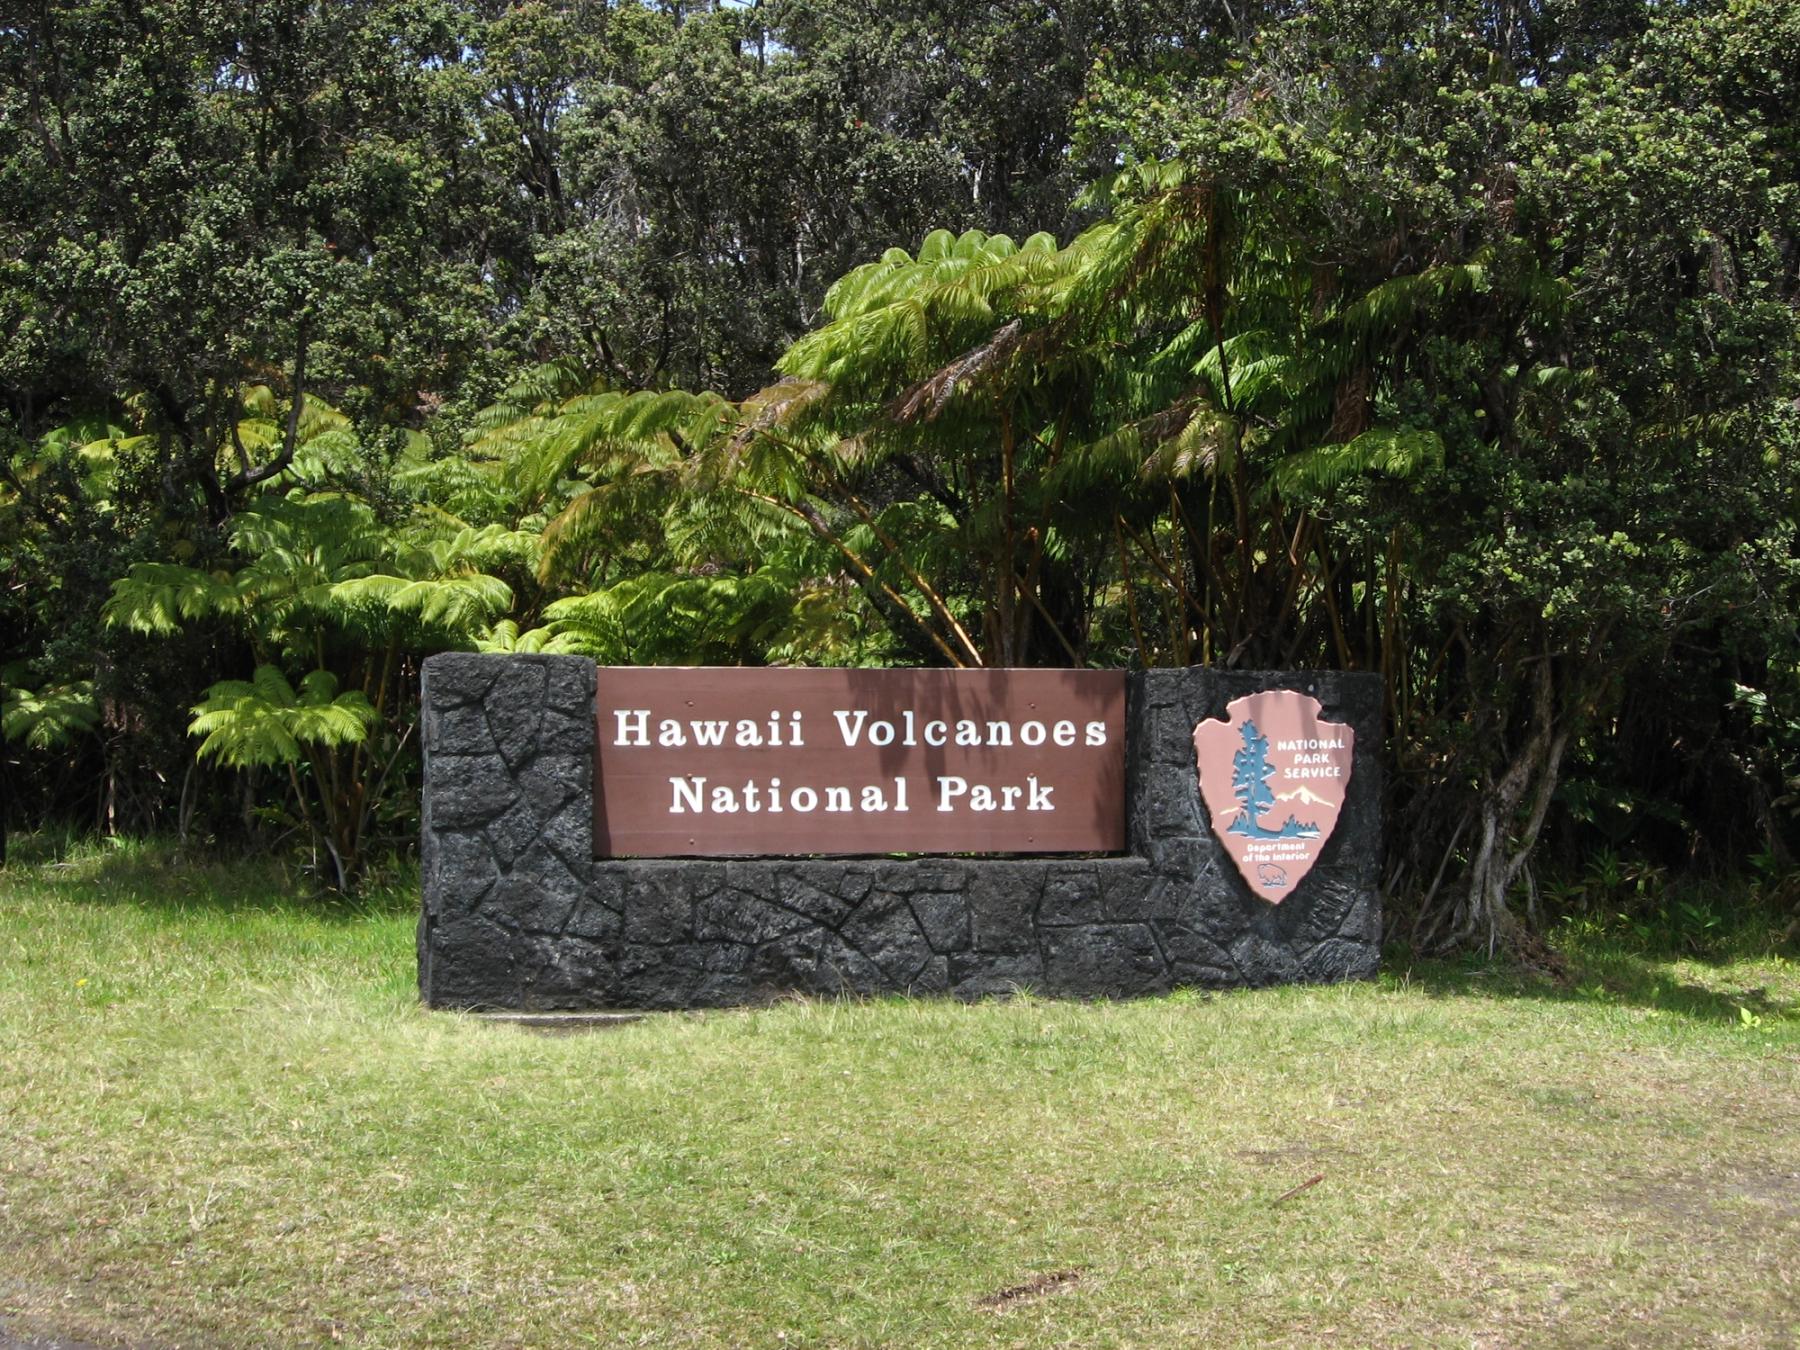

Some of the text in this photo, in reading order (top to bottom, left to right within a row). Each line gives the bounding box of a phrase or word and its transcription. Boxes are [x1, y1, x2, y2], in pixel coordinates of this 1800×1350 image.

[612, 709, 1108, 747] Hawaii Volcanoes
[1277, 739, 1345, 751] NATIONAL
[1294, 753, 1330, 764] PARK
[1284, 766, 1341, 779] SERVICE
[668, 776, 1056, 814] National Park
[1247, 842, 1305, 853] Department
[1242, 854, 1254, 862] of
[1255, 853, 1270, 862] the
